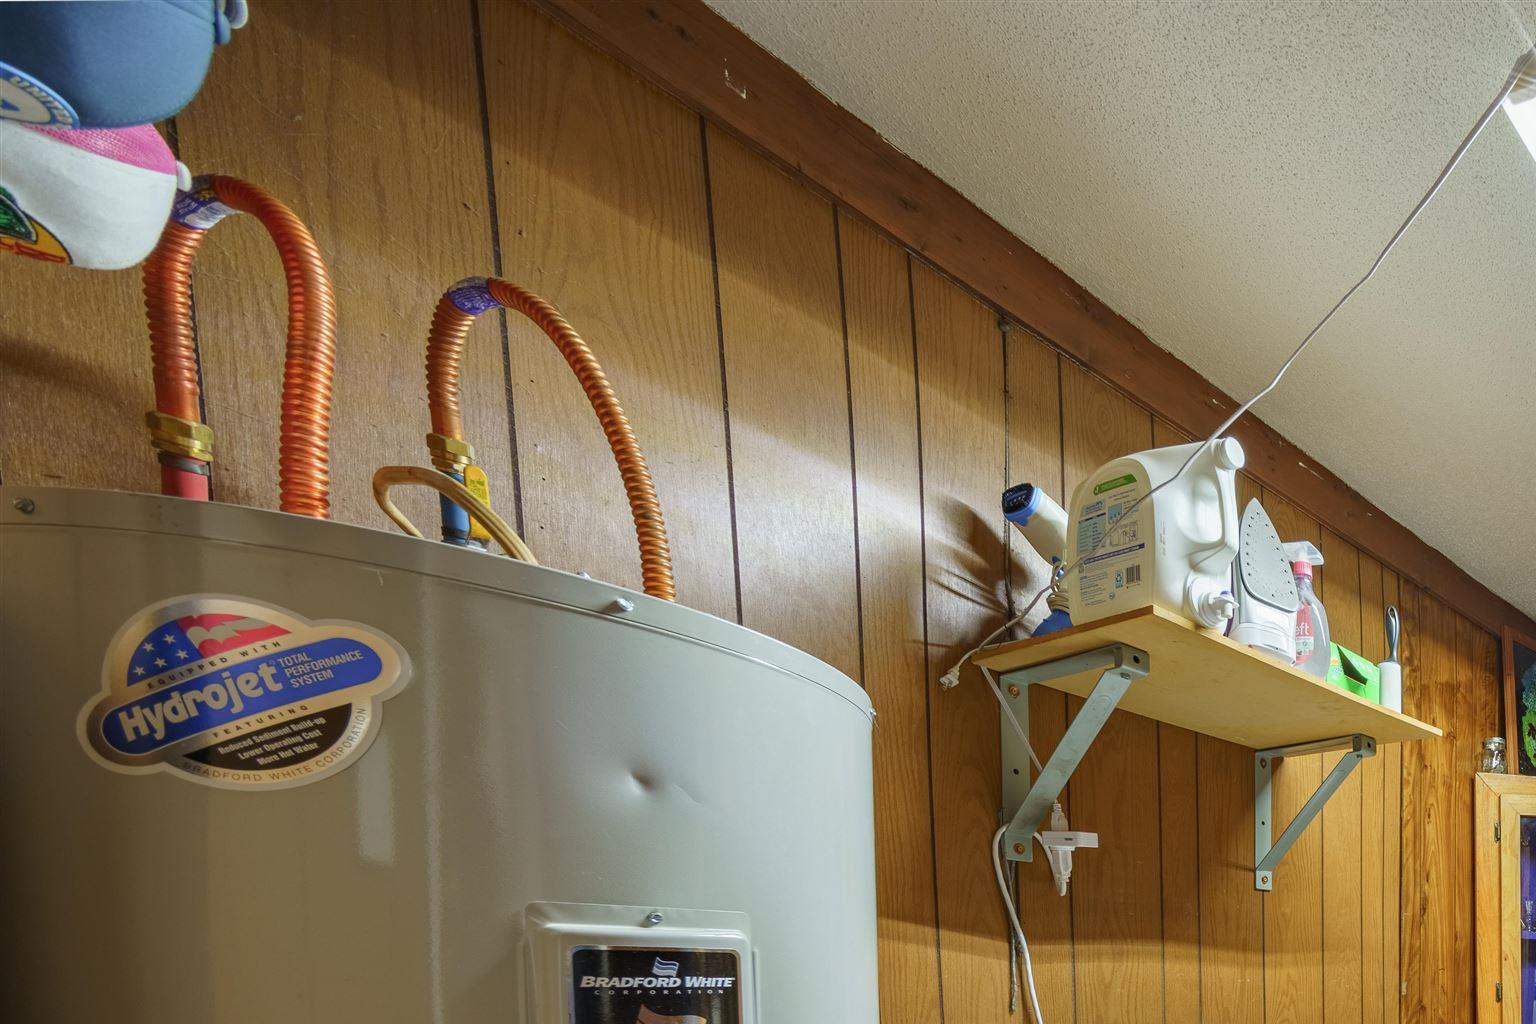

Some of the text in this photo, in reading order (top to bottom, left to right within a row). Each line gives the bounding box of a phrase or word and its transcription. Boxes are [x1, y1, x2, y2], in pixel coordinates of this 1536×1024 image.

[147, 641, 281, 689] EQUIPPED WITH
[278, 652, 312, 667] TOTAL
[284, 650, 364, 678] PERFORMANCE
[290, 669, 334, 688] SYSTEM
[118, 662, 283, 742] Hydrojet
[212, 705, 309, 739] FEATURING
[218, 716, 327, 754] Reduced Sediment Build-up
[182, 707, 368, 782] BRADFORD WHITE CORPORATION
[237, 729, 324, 760] Lower Operating Cost
[256, 741, 320, 766] More Hot Water
[580, 976, 734, 988] BRADFORD WHITE
